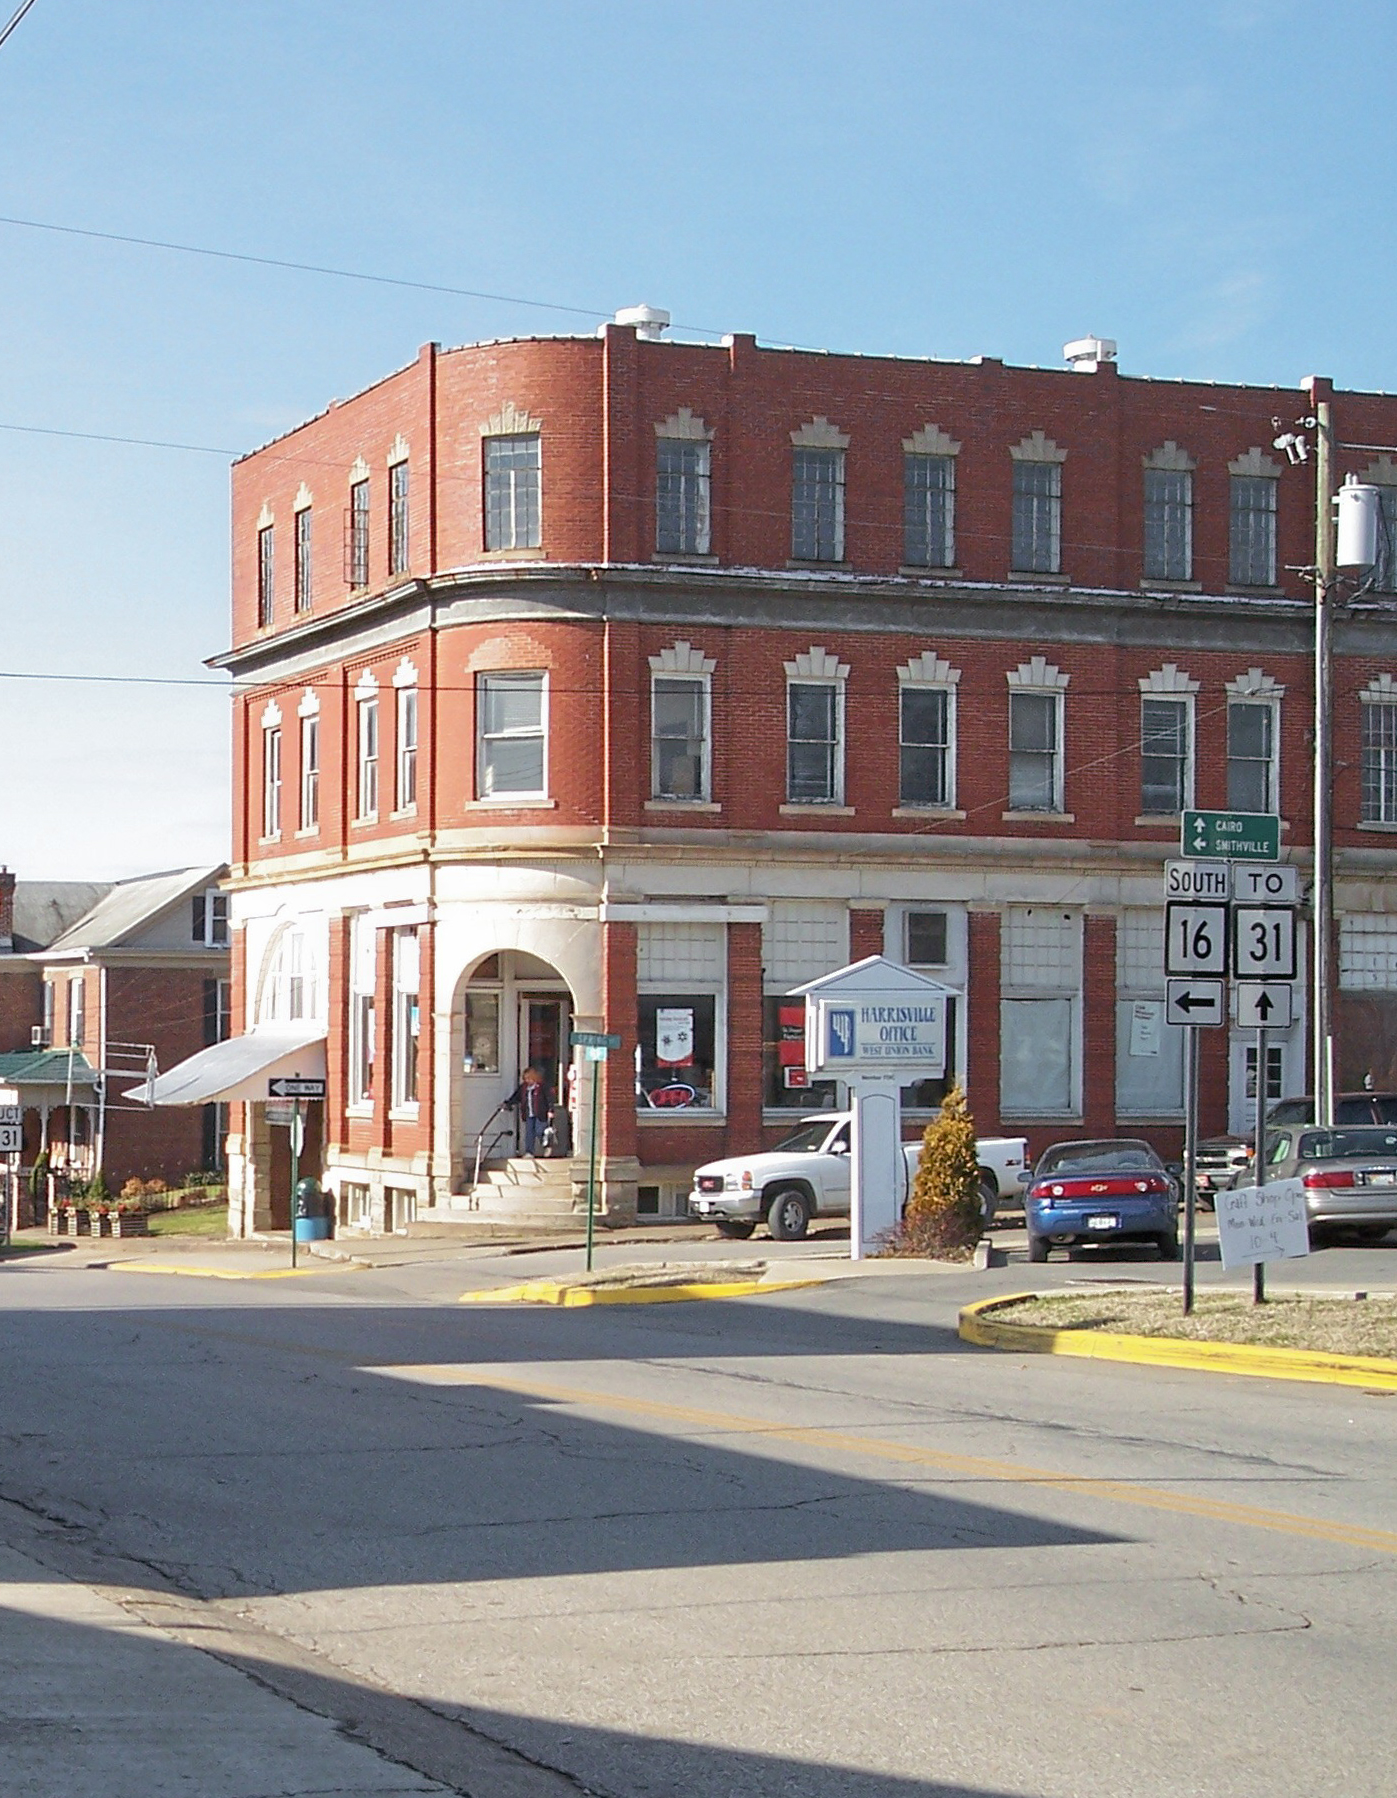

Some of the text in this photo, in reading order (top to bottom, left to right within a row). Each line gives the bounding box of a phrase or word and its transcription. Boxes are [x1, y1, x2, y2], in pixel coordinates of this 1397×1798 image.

[1215, 820, 1243, 833] CAIRO
[1215, 839, 1269, 853] SMITHVILLE
[1169, 868, 1226, 893] SOUTH
[1249, 873, 1283, 894] TO
[1181, 919, 1212, 960] 16
[1249, 922, 1281, 962] 31
[861, 1007, 936, 1022] HARRISVILLE
[880, 1026, 917, 1041] OFFICE
[862, 1045, 934, 1055] WEST UNION BANK
[285, 1083, 321, 1092] ONE WAY
[0, 1107, 19, 1120] JCT
[1, 1130, 17, 1146] 31
